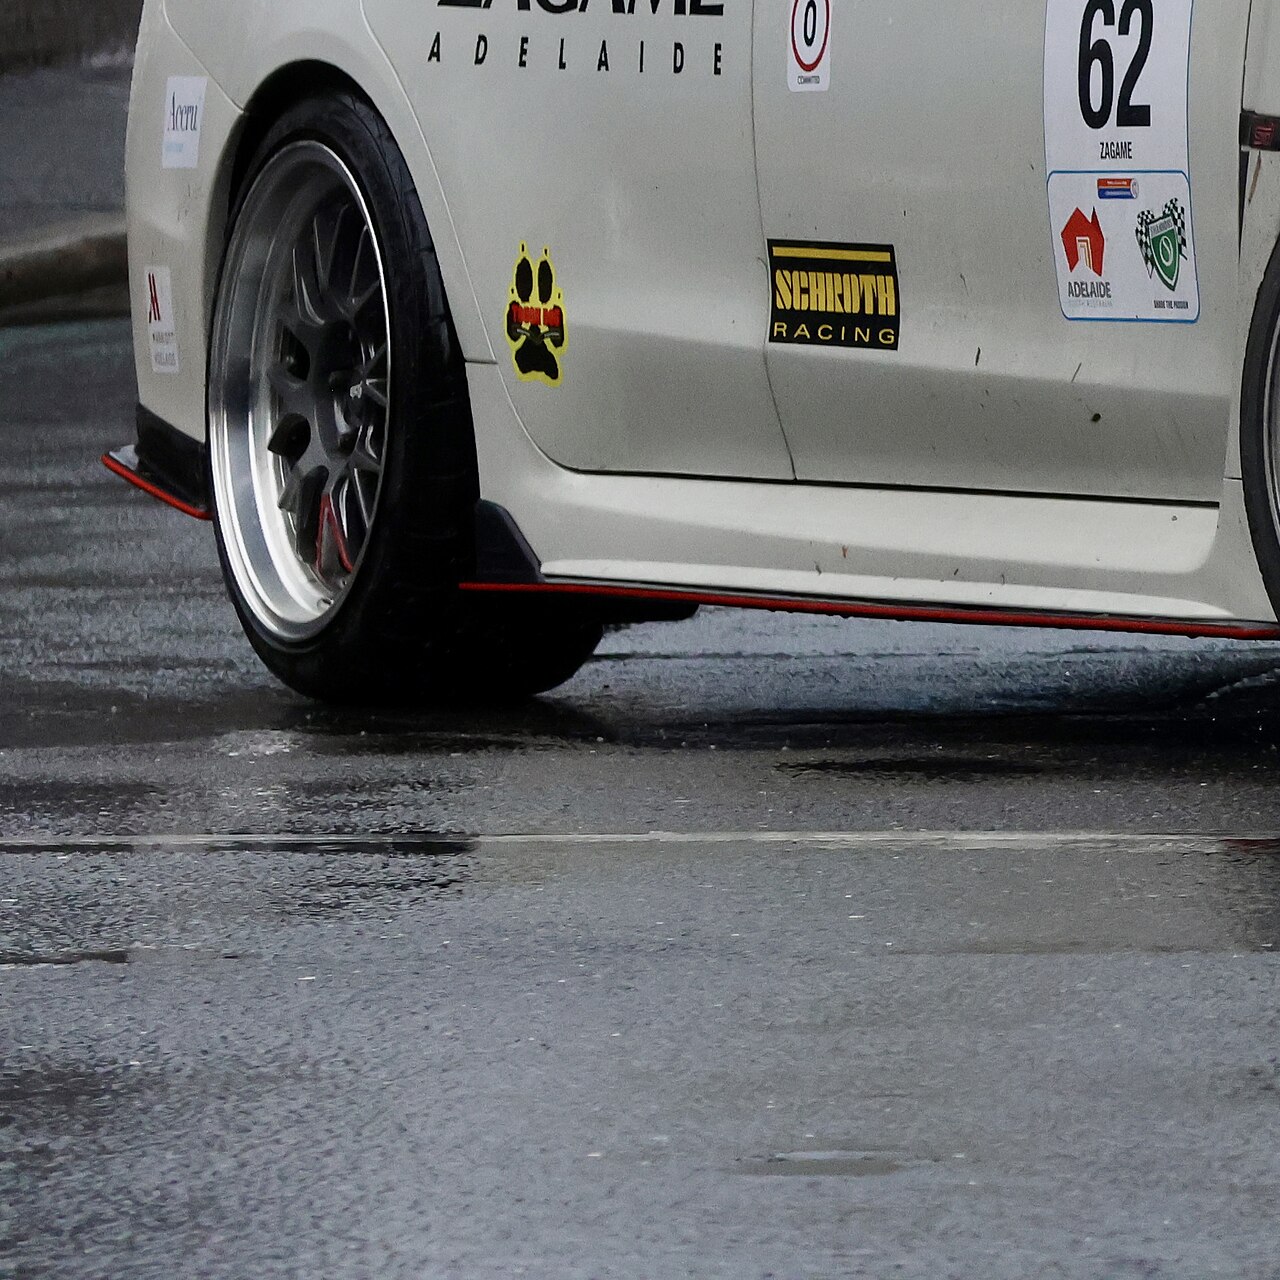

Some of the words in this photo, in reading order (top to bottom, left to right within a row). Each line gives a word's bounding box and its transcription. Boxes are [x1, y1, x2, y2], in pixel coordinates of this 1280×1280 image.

[803, 0, 817, 47] 0
[427, 31, 722, 76] ADELAIDE
[1100, 141, 1133, 160] ZAGAME
[775, 269, 896, 316] SCHROTH
[1068, 281, 1112, 298] ADELAIDE
[773, 322, 896, 345] RACING
